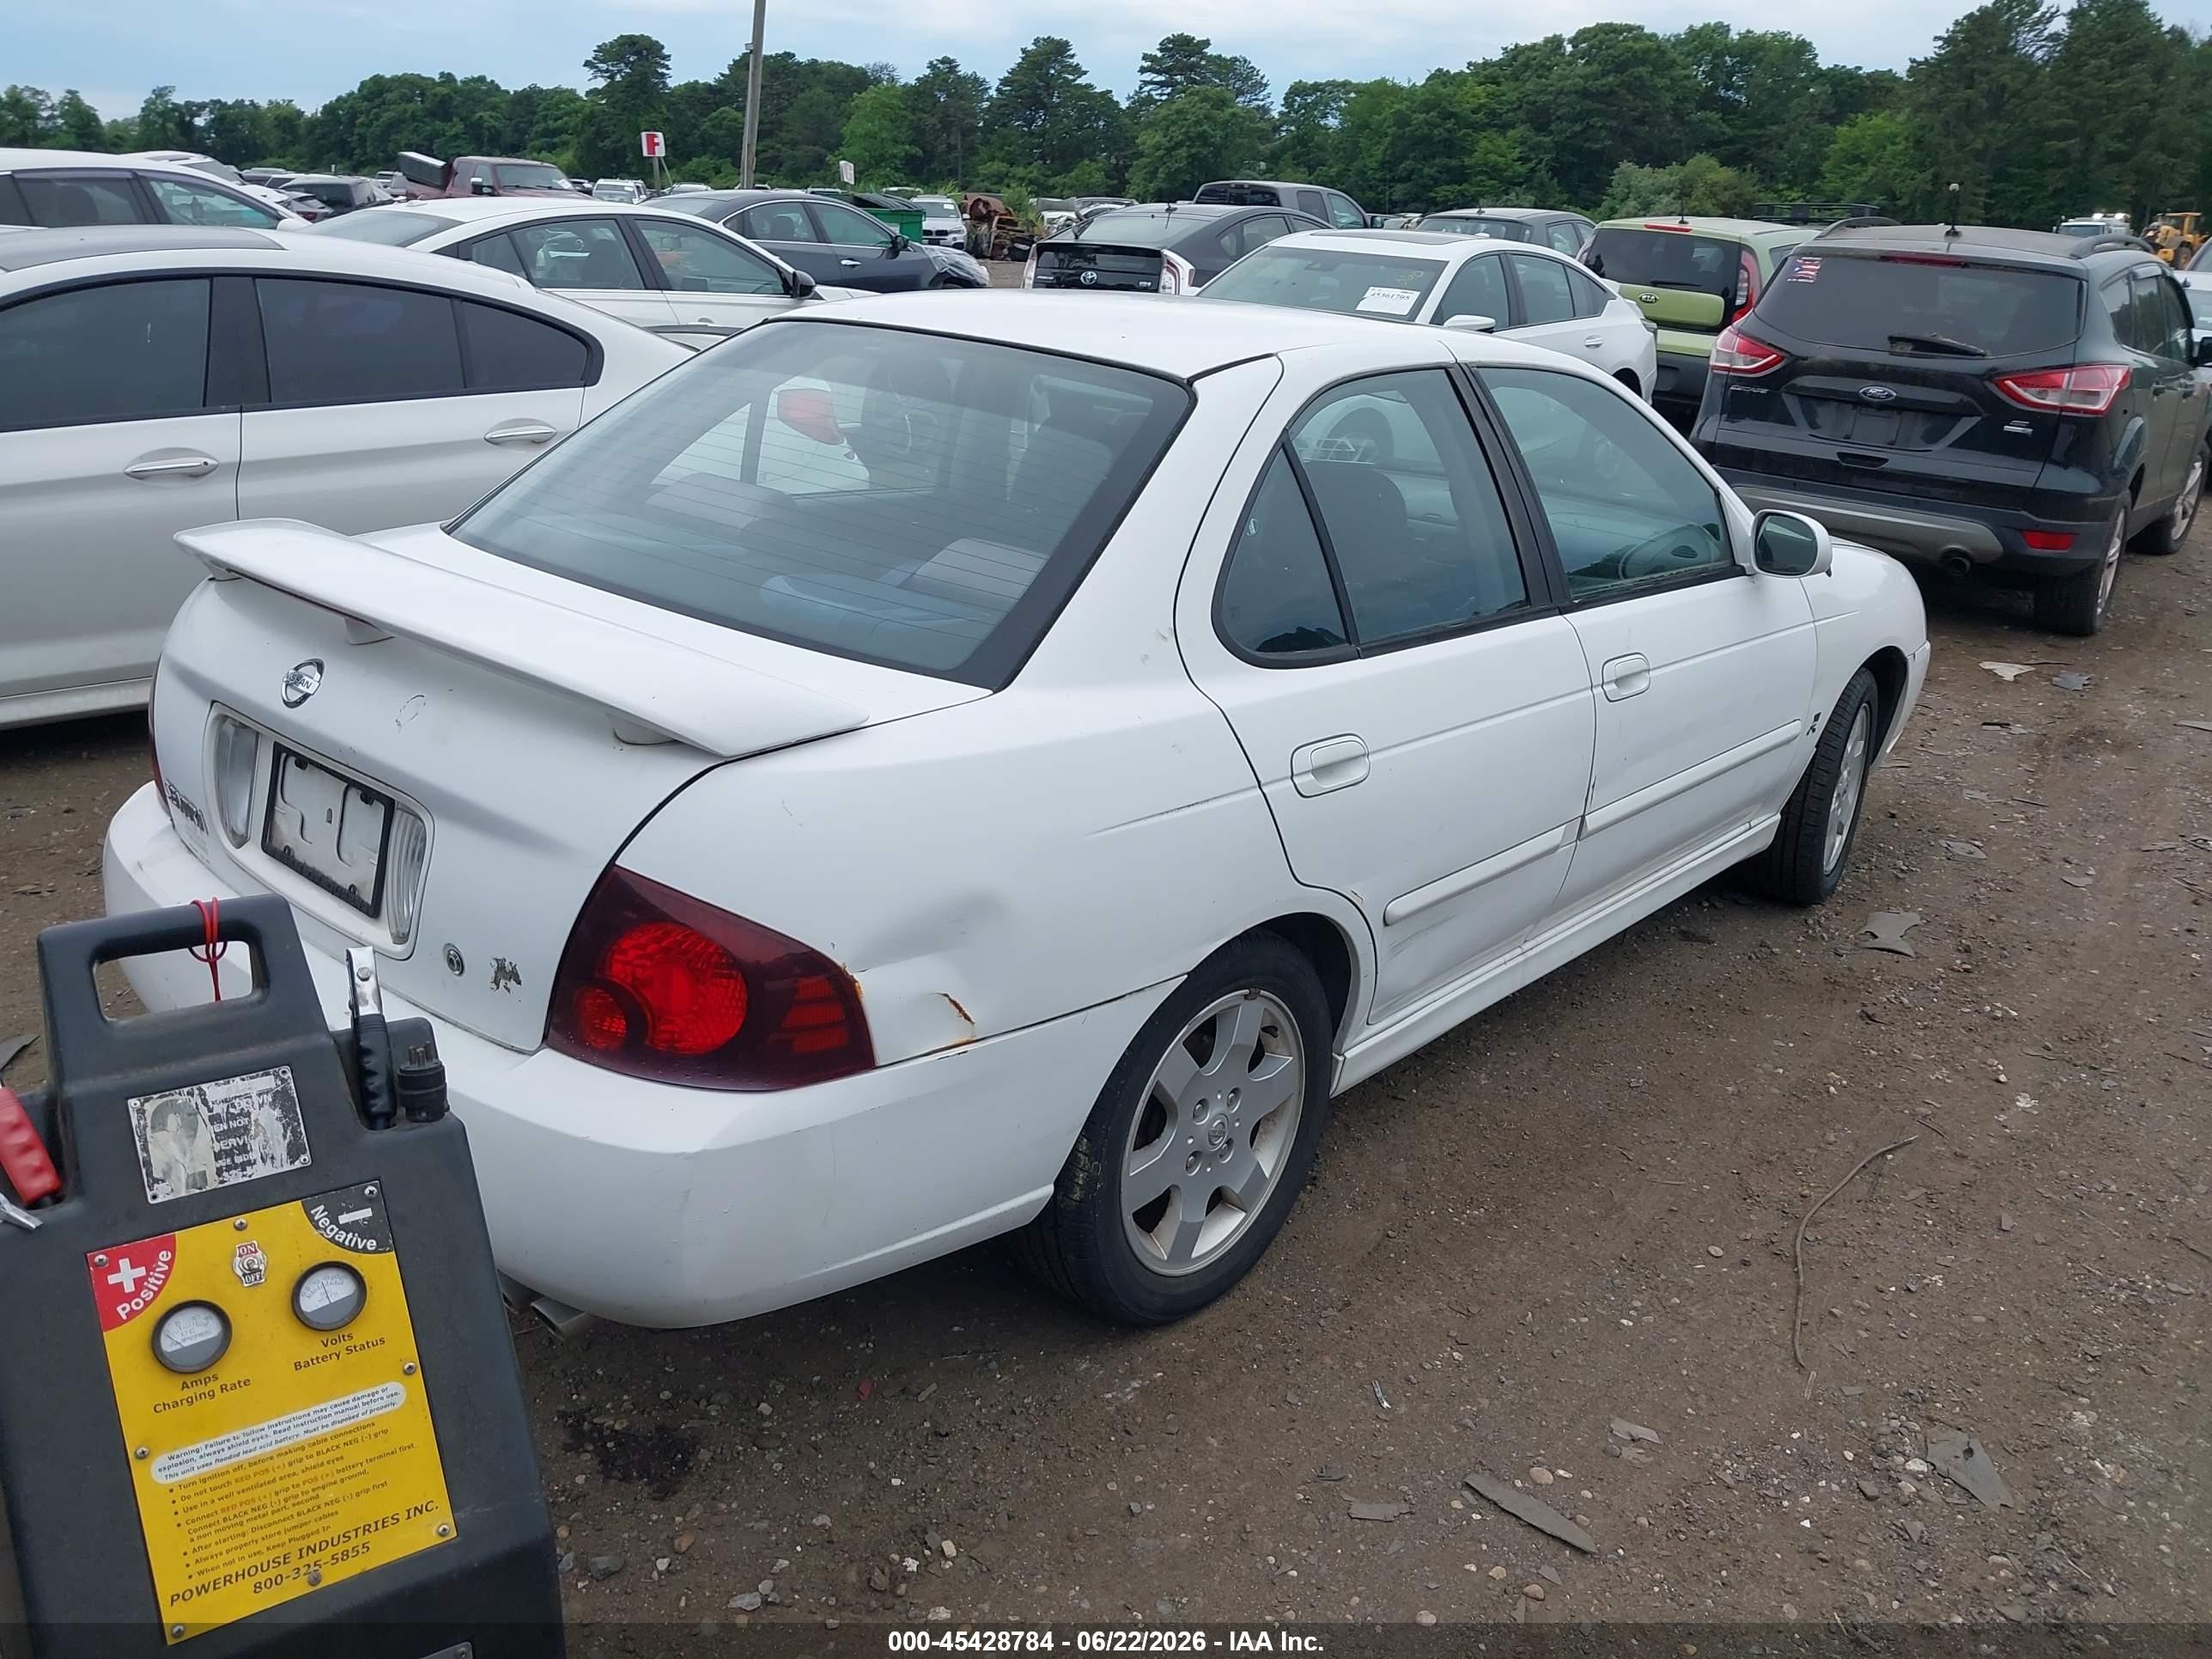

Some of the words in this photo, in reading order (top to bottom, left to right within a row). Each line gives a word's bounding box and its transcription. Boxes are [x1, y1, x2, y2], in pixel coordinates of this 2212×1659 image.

[646, 134, 659, 155] F
[237, 1243, 257, 1255] ON
[311, 1204, 376, 1251] Negative
[116, 1249, 172, 1320] Positive
[244, 1272, 263, 1284] OFF
[294, 1351, 341, 1371] Battery
[345, 1336, 386, 1355] Status
[321, 1332, 354, 1348] Volts
[153, 1389, 215, 1414] Charging
[220, 1377, 251, 1394] Rate
[180, 1373, 219, 1391] Amps
[165, 1471, 179, 1480] This
[180, 1466, 195, 1474] unit
[214, 1451, 240, 1464] flooded
[241, 1445, 257, 1455] lead
[258, 1440, 273, 1449] acid
[302, 1425, 319, 1435] Must
[331, 1413, 360, 1427] disposed
[198, 1445, 225, 1461] always
[227, 1437, 249, 1449] shield
[272, 1425, 291, 1435] Read
[293, 1411, 332, 1429] instruction
[333, 1402, 360, 1415] manual
[362, 1395, 384, 1407] before
[204, 1436, 230, 1449] Failure
[267, 1411, 310, 1429] instructions
[313, 1407, 327, 1416] may
[330, 1400, 349, 1409] cause
[351, 1389, 379, 1403] damage
[178, 1479, 197, 1490] Turn
[198, 1468, 230, 1485] ignition
[248, 1454, 274, 1467] before
[276, 1443, 306, 1460] making
[307, 1437, 328, 1448] cable
[330, 1421, 375, 1440] connections
[193, 1487, 207, 1497] not
[209, 1480, 232, 1492] touch
[234, 1473, 251, 1483] RED
[252, 1467, 270, 1477] POS
[287, 1455, 304, 1468] grip
[315, 1443, 340, 1456] BLACK
[343, 1437, 359, 1447] NEG
[182, 1503, 198, 1513] Use
[216, 1491, 234, 1501] well
[236, 1477, 276, 1495] ventilated
[301, 1461, 324, 1474] shield
[325, 1455, 343, 1466] eyes
[185, 1509, 218, 1526] Connect
[220, 1503, 236, 1514] RED
[239, 1497, 255, 1507] POS
[273, 1485, 290, 1497] grip
[301, 1475, 318, 1486] POS
[335, 1460, 364, 1475] battery
[365, 1448, 397, 1463] terminal
[398, 1442, 414, 1452] first
[187, 1519, 221, 1535] Connect
[222, 1509, 248, 1523] BLACK
[251, 1503, 267, 1513] NEG
[283, 1492, 300, 1504] grip
[311, 1479, 337, 1494] engine
[191, 1541, 212, 1553] After
[251, 1513, 295, 1533] Disconnect
[296, 1503, 321, 1516] BLACK
[324, 1497, 340, 1507] NEG
[355, 1486, 370, 1498] grip
[372, 1480, 387, 1490] first
[193, 1550, 223, 1566] Always
[225, 1537, 258, 1555] properly
[260, 1529, 282, 1541] store
[283, 1520, 311, 1534] jumper
[313, 1509, 338, 1522] cables
[197, 1531, 212, 1540] non
[213, 1519, 244, 1535] moving
[246, 1510, 268, 1522] metal
[291, 1492, 319, 1507] second
[168, 1552, 293, 1606] POWERHOUSE
[295, 1512, 401, 1559] INDUSTRIES
[404, 1498, 439, 1520] INC.
[196, 1563, 220, 1577] When
[222, 1558, 235, 1567] not
[265, 1540, 287, 1553] Keep
[288, 1528, 319, 1545] Plugged
[321, 1523, 331, 1532] In
[252, 1540, 372, 1594] 800-325-5855
